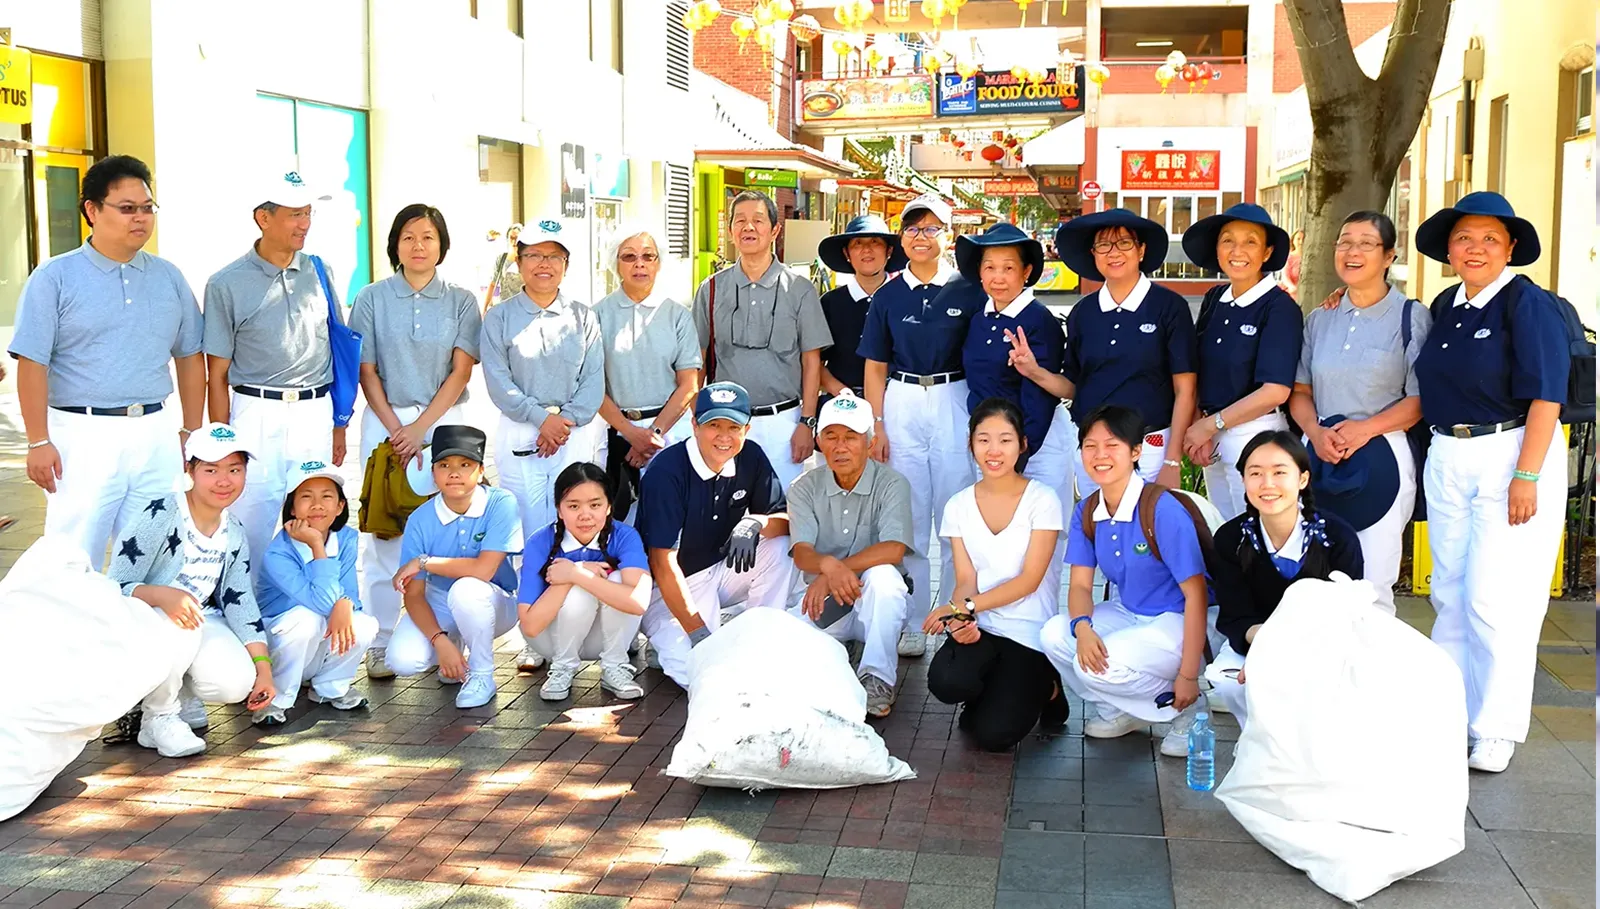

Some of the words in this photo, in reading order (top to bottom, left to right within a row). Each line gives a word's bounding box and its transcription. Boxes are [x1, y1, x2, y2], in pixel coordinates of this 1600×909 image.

[978, 86, 1021, 101] FOOD
[1024, 83, 1078, 99] COURT
[985, 183, 1012, 193] FOOD
